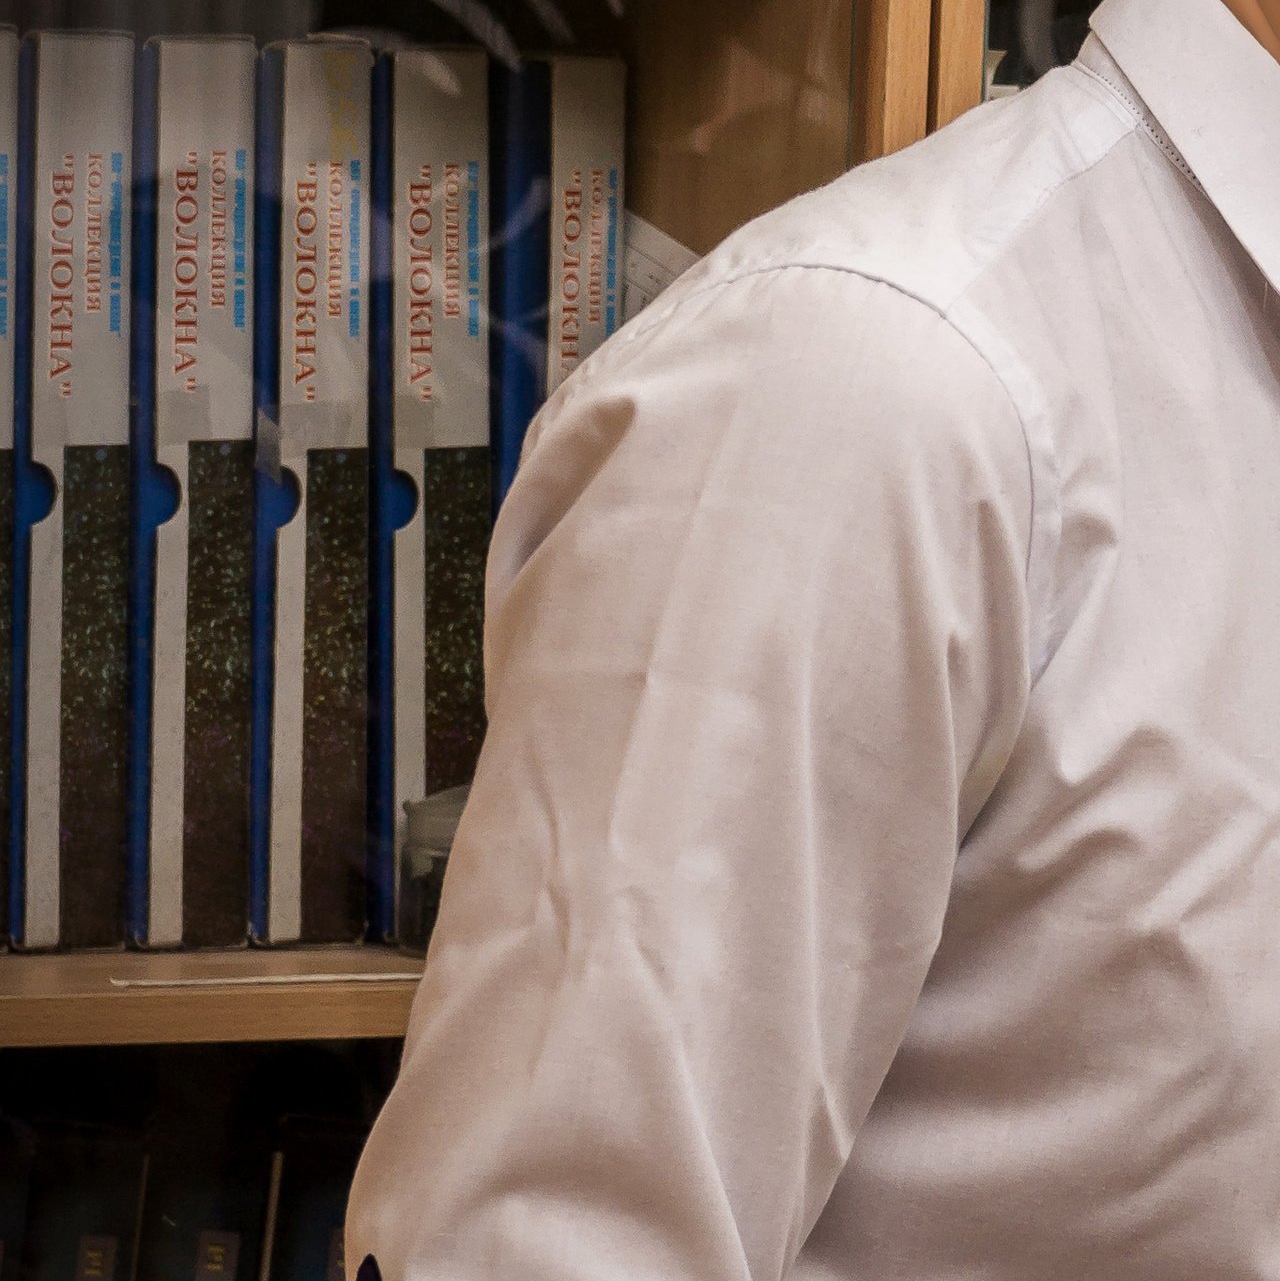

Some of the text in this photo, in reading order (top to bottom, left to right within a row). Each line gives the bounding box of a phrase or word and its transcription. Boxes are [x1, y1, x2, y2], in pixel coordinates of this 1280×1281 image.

[50, 152, 75, 398] "ВОЛОКНА"
[84, 152, 104, 314] КОЛЛЕКЦИЯ
[174, 150, 200, 392] "ВОЛОКНА"
[207, 149, 228, 308] КОЛЛЕКЦИЯ
[294, 160, 318, 403] "ВОЛОКНА"
[408, 163, 433, 403] "ВОЛОКНА"
[560, 168, 583, 376] "ВОЛОКН
